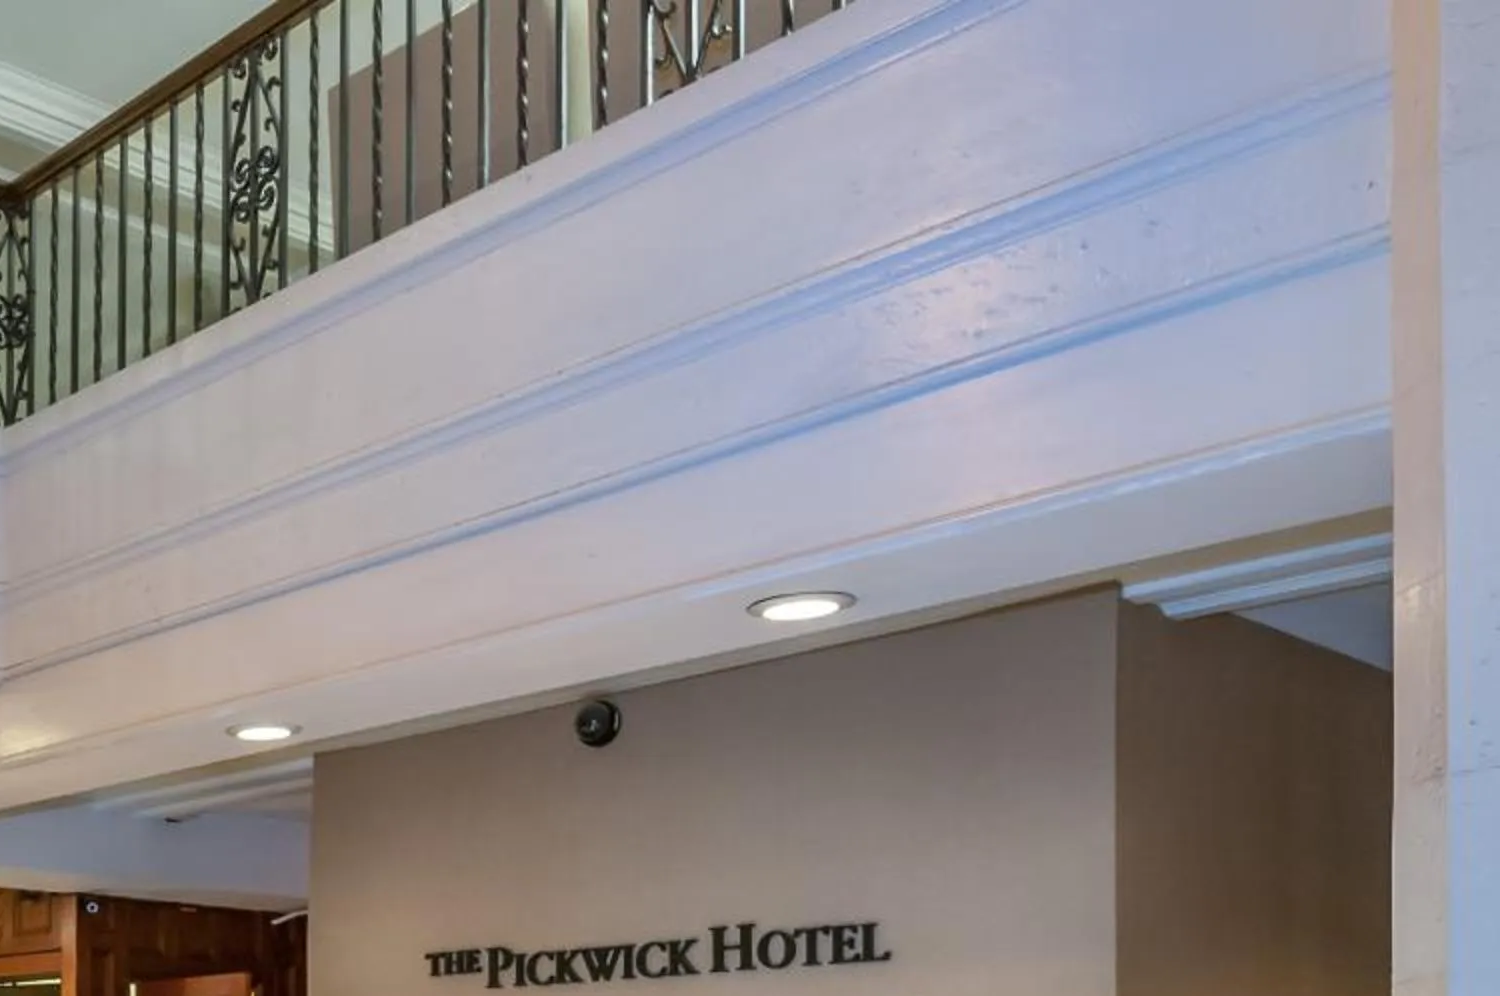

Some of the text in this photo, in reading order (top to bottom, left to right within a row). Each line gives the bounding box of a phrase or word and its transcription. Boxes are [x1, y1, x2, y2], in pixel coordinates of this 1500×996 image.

[424, 922, 893, 989] THE PICKWICK HOTEL
